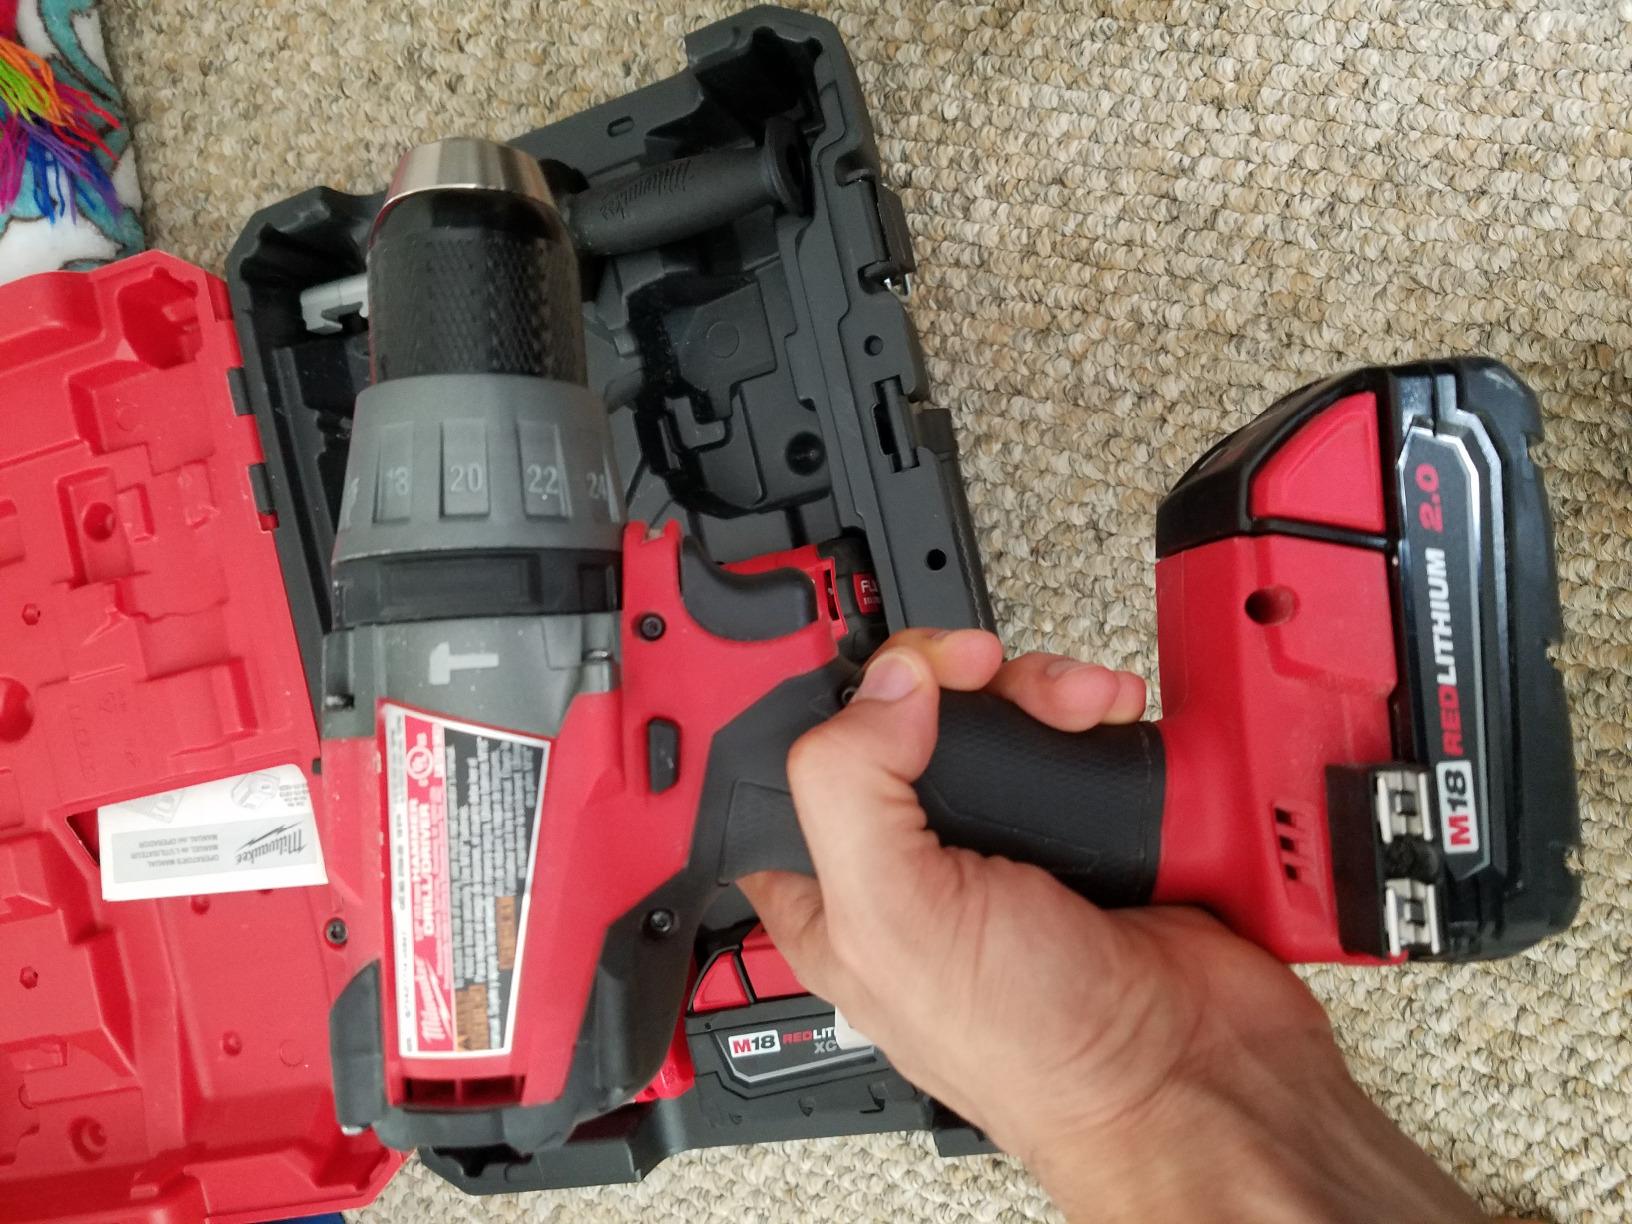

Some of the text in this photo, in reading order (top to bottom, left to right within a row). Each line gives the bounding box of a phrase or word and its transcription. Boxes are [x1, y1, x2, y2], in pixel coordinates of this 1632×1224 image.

[450, 462, 483, 493] 20
[527, 464, 559, 495] 22
[1415, 463, 1472, 848] M18 REDLITHIUM 2.0
[235, 828, 308, 865] Milwaukee
[732, 1026, 836, 1054] M18 REDLIT
[814, 1039, 838, 1054] XC
